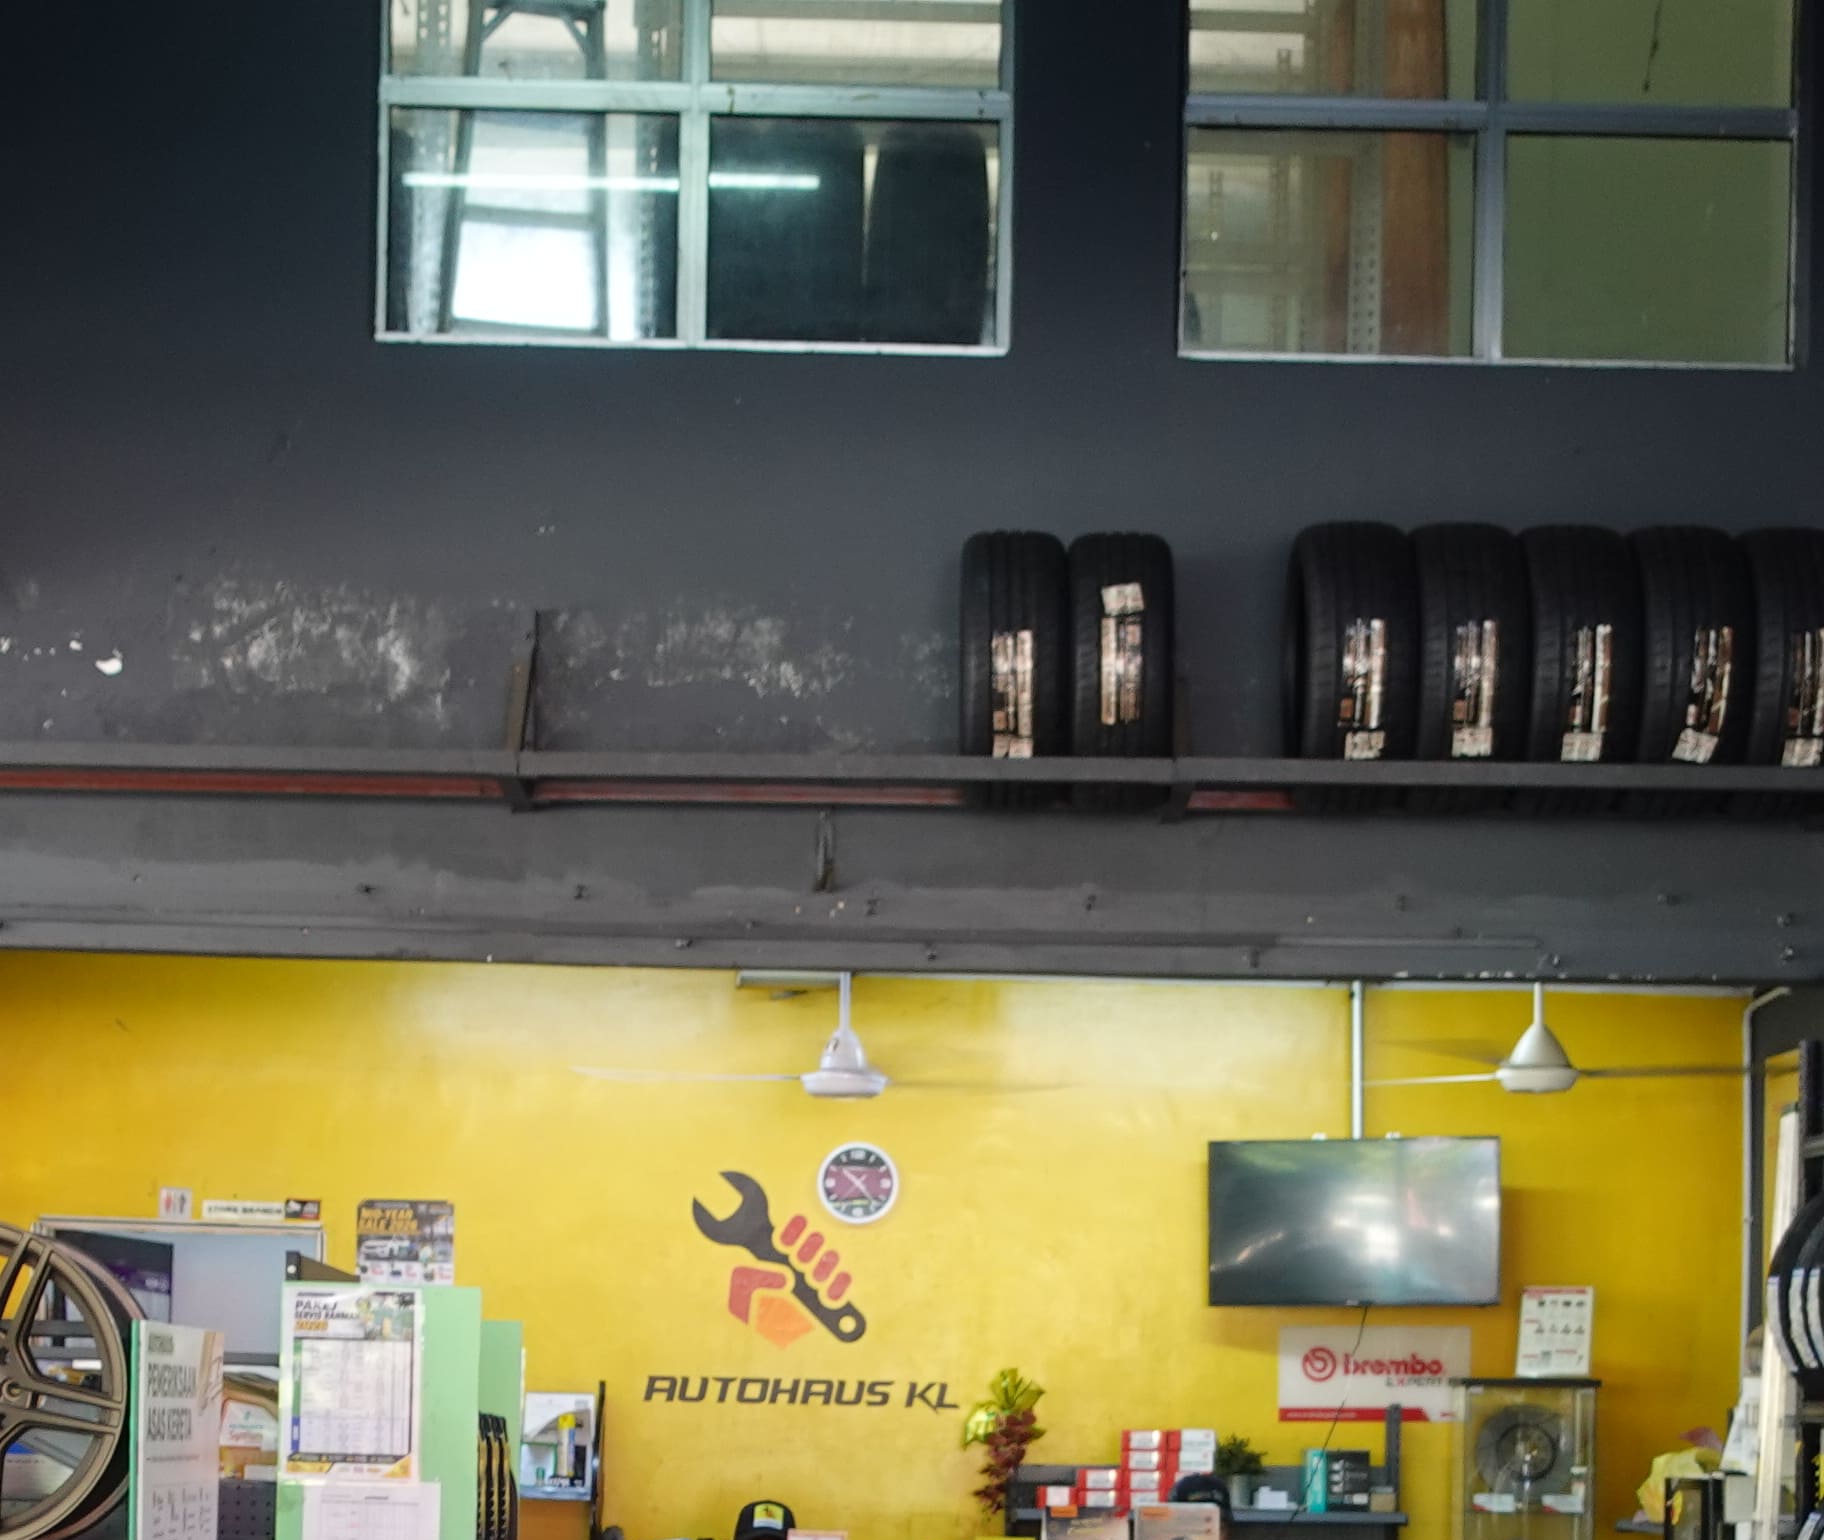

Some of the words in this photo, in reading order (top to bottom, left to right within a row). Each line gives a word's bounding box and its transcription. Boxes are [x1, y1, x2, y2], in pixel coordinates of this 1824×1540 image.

[1342, 1352, 1444, 1377] brembo
[643, 1375, 895, 1407] AUTOHAUS
[904, 1381, 960, 1415] KL
